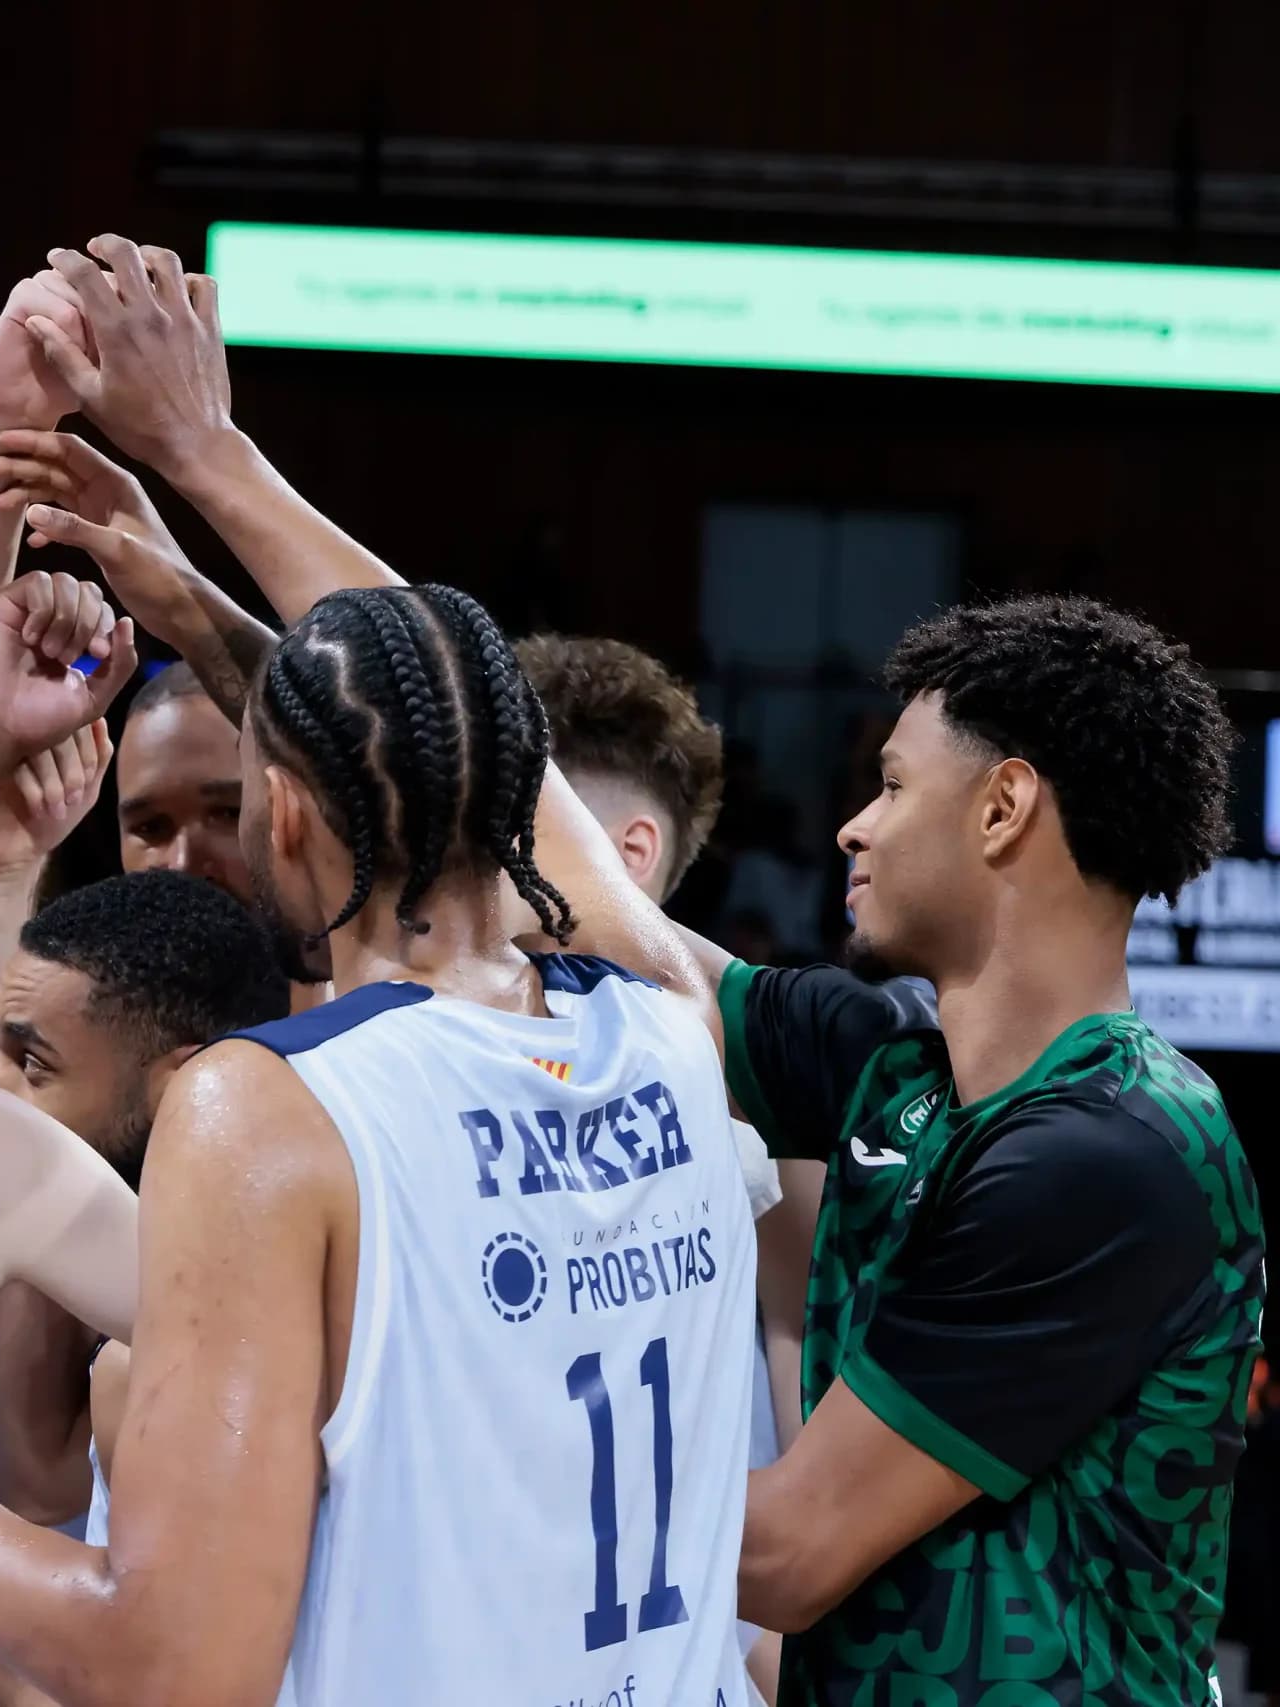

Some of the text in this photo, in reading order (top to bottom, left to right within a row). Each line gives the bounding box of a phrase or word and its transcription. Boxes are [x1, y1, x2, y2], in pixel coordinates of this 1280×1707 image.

[458, 1080, 694, 1198] PARKER
[566, 1227, 716, 1314] PROBITAS
[566, 1336, 689, 1652] 11
